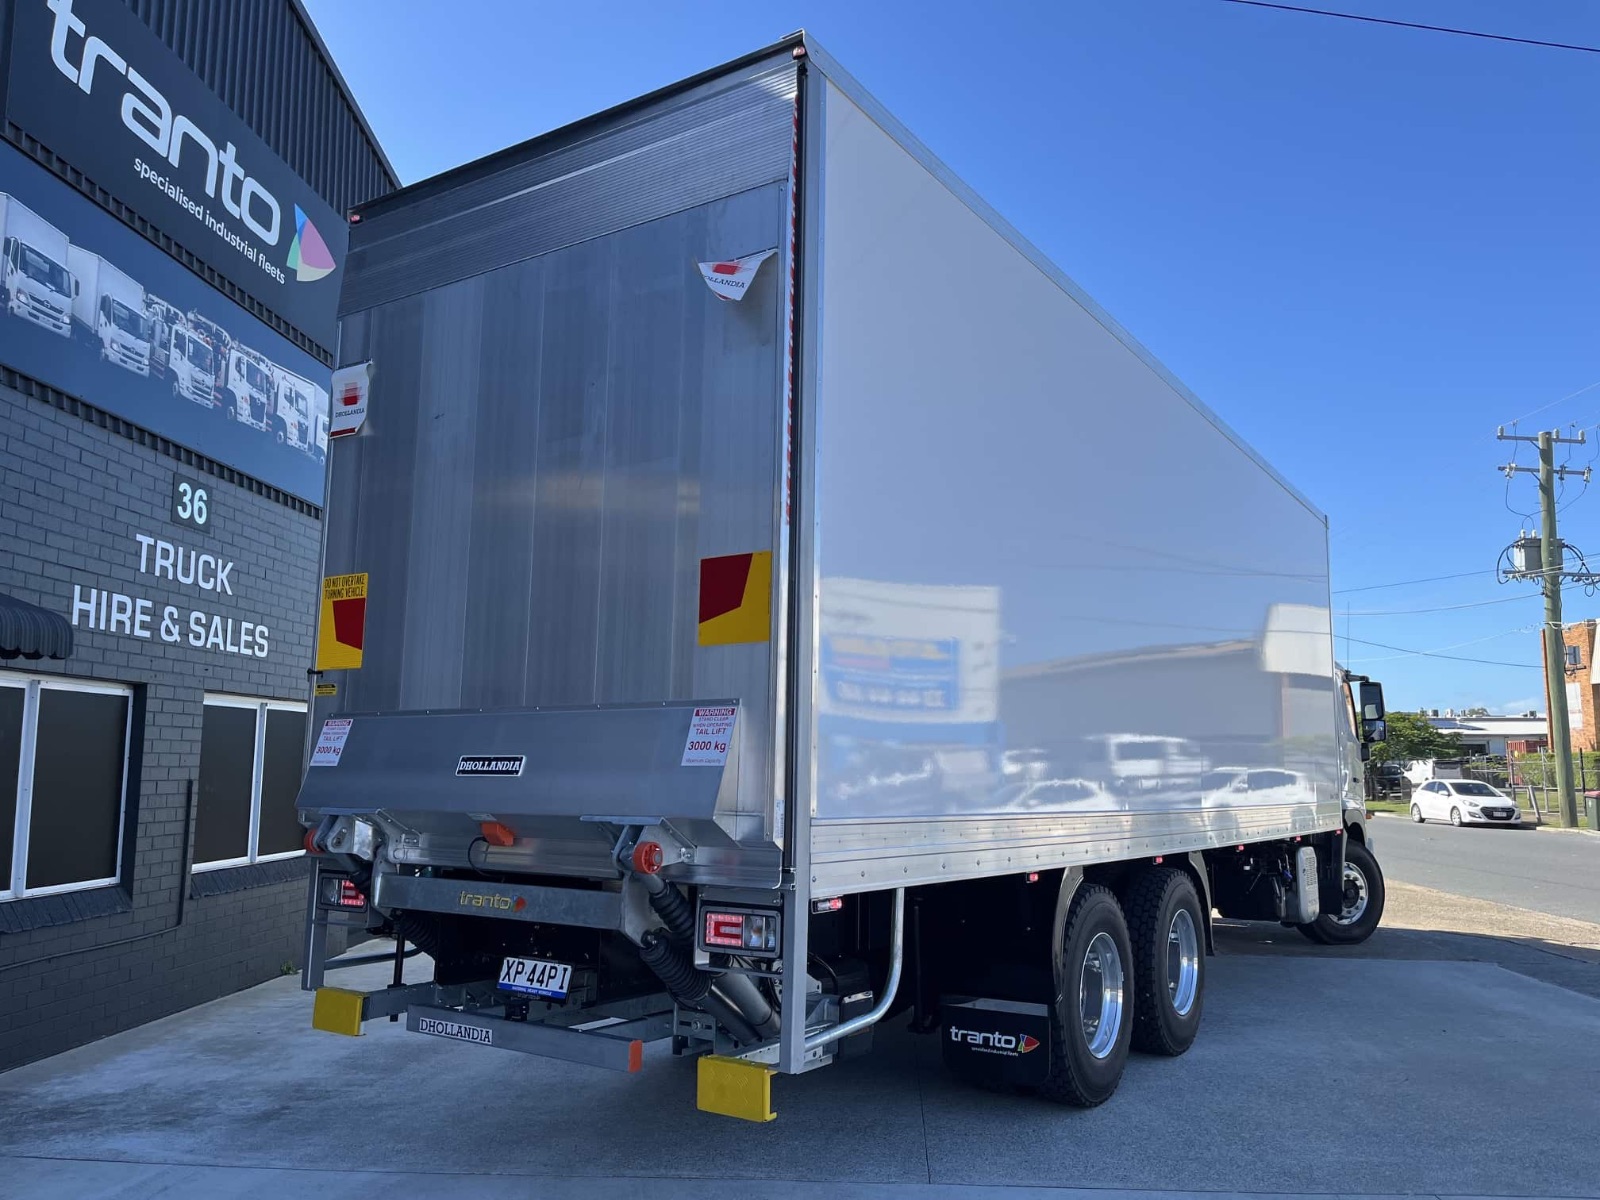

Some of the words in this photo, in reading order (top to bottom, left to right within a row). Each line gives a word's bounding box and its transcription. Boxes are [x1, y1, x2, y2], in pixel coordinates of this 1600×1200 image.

[47, 0, 281, 246] tranto
[133, 158, 204, 221] specialised
[205, 210, 257, 262] industrial
[258, 252, 285, 285] fleets
[177, 482, 208, 525] 36
[135, 533, 234, 596] TRUCK
[71, 585, 153, 638] HIRE
[160, 606, 181, 643] &
[188, 611, 269, 658] SALES
[698, 708, 732, 716] WARNING
[333, 746, 341, 756] kg
[688, 741, 712, 751] 3000
[714, 740, 727, 753] kg
[459, 761, 520, 771] DHOLLANDIA
[460, 890, 511, 910] tranto
[420, 1019, 491, 1043] DHOLLANDIA
[949, 1025, 1016, 1049] tranto
